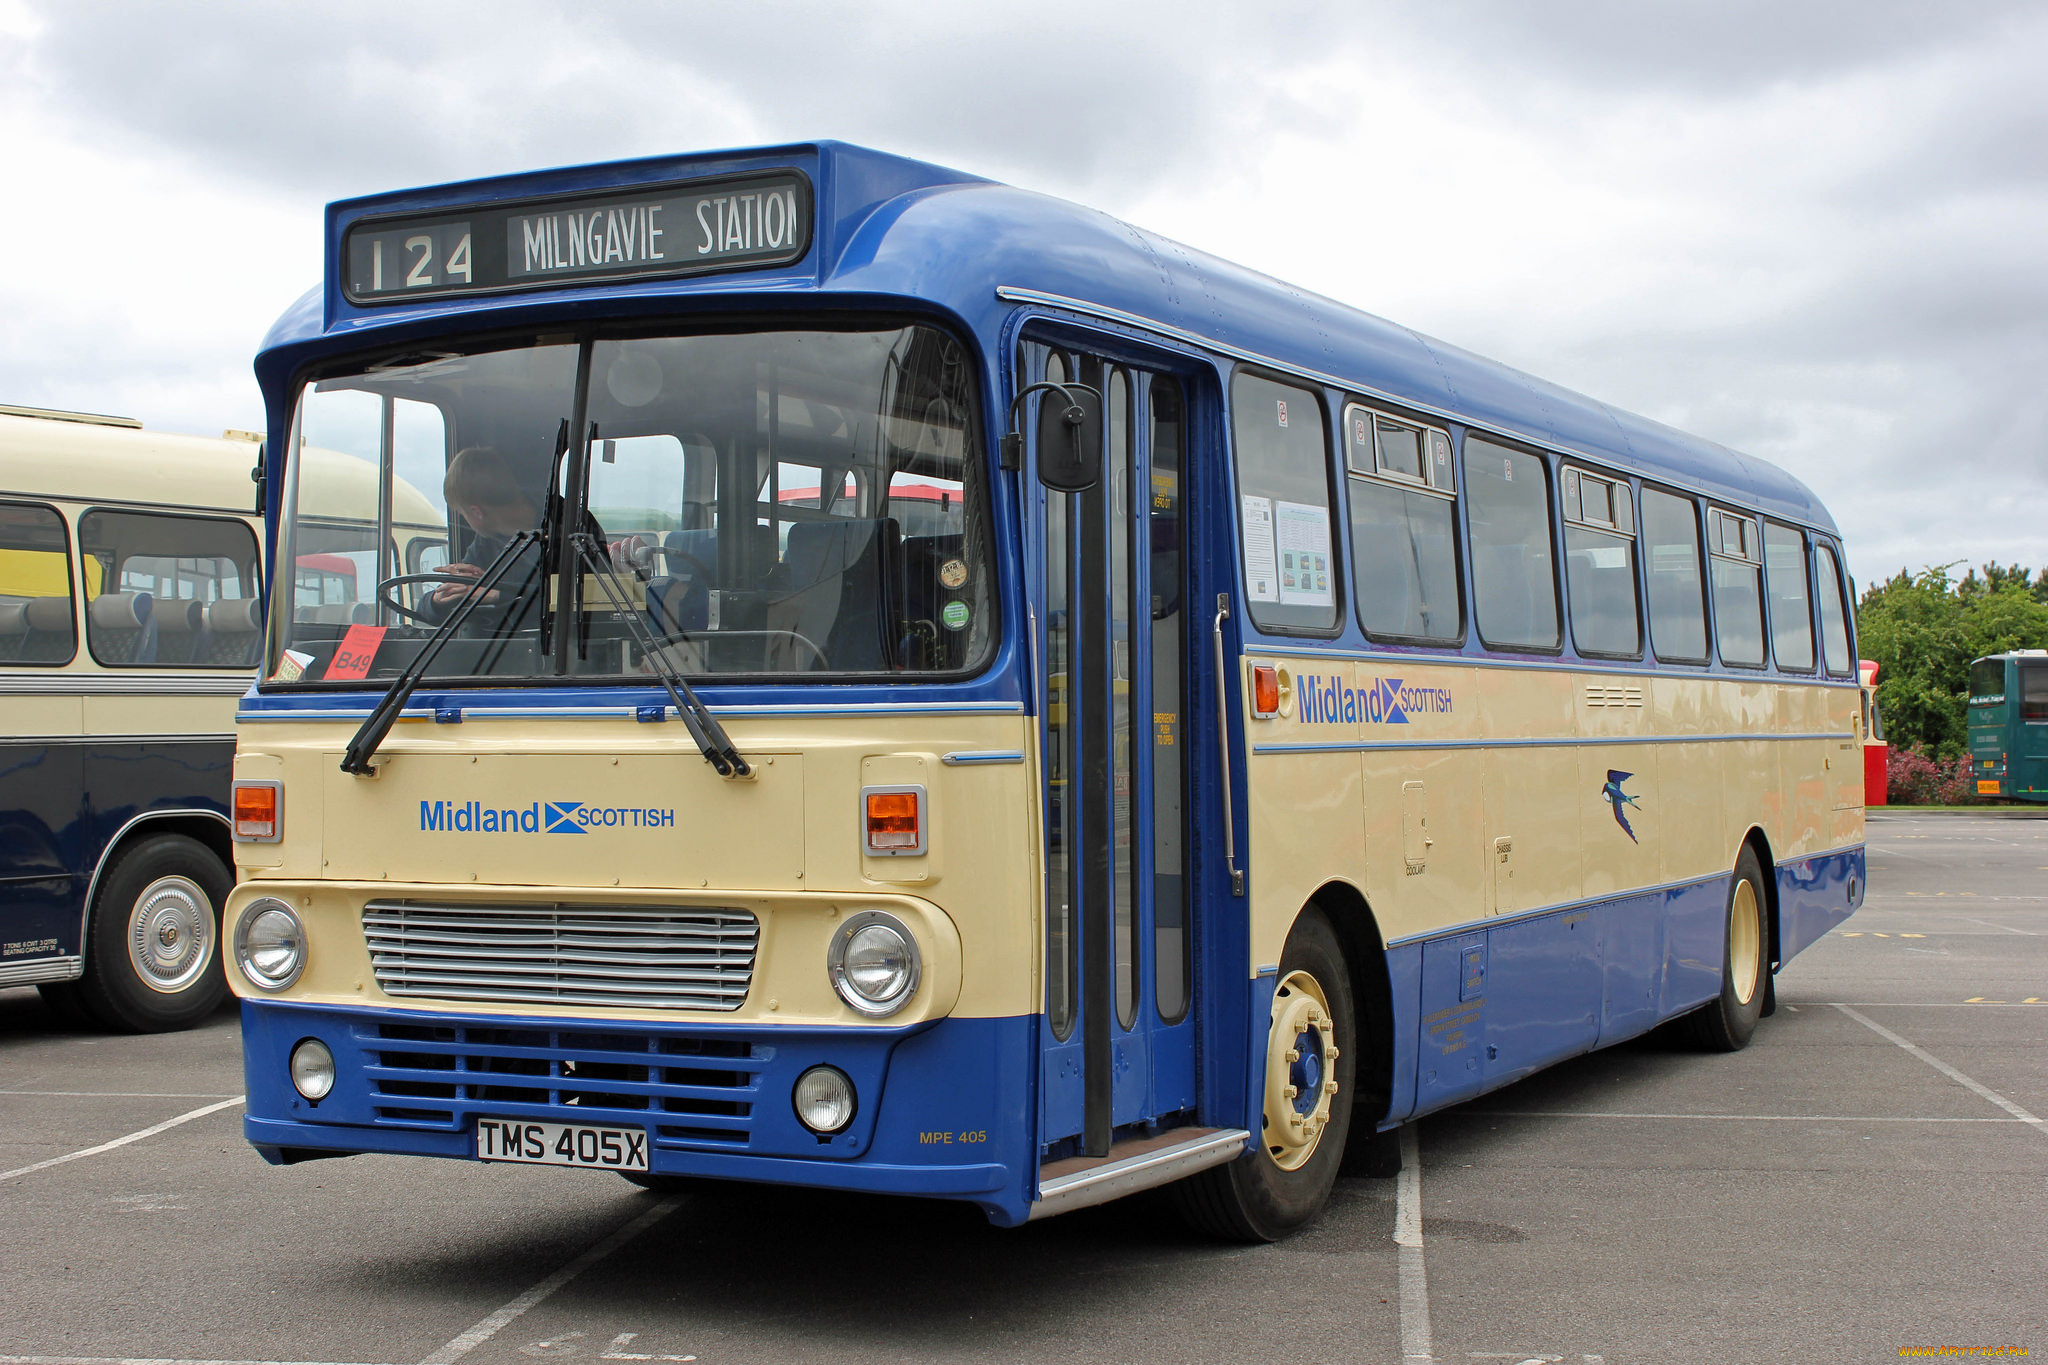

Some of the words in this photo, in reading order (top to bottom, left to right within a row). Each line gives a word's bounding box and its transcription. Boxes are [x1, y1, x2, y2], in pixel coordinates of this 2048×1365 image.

[373, 233, 472, 290] 124
[523, 205, 664, 271] MILNGAVIE
[335, 651, 371, 672] B49
[1297, 675, 1382, 723] Midland
[1401, 687, 1453, 712] SCOTTISH
[420, 800, 539, 833] Midland
[577, 808, 674, 827] SCOTTISH
[480, 1121, 545, 1159] TMS
[555, 1128, 646, 1167] 405X
[919, 1131, 953, 1144] MPE
[958, 1130, 987, 1143] 405
